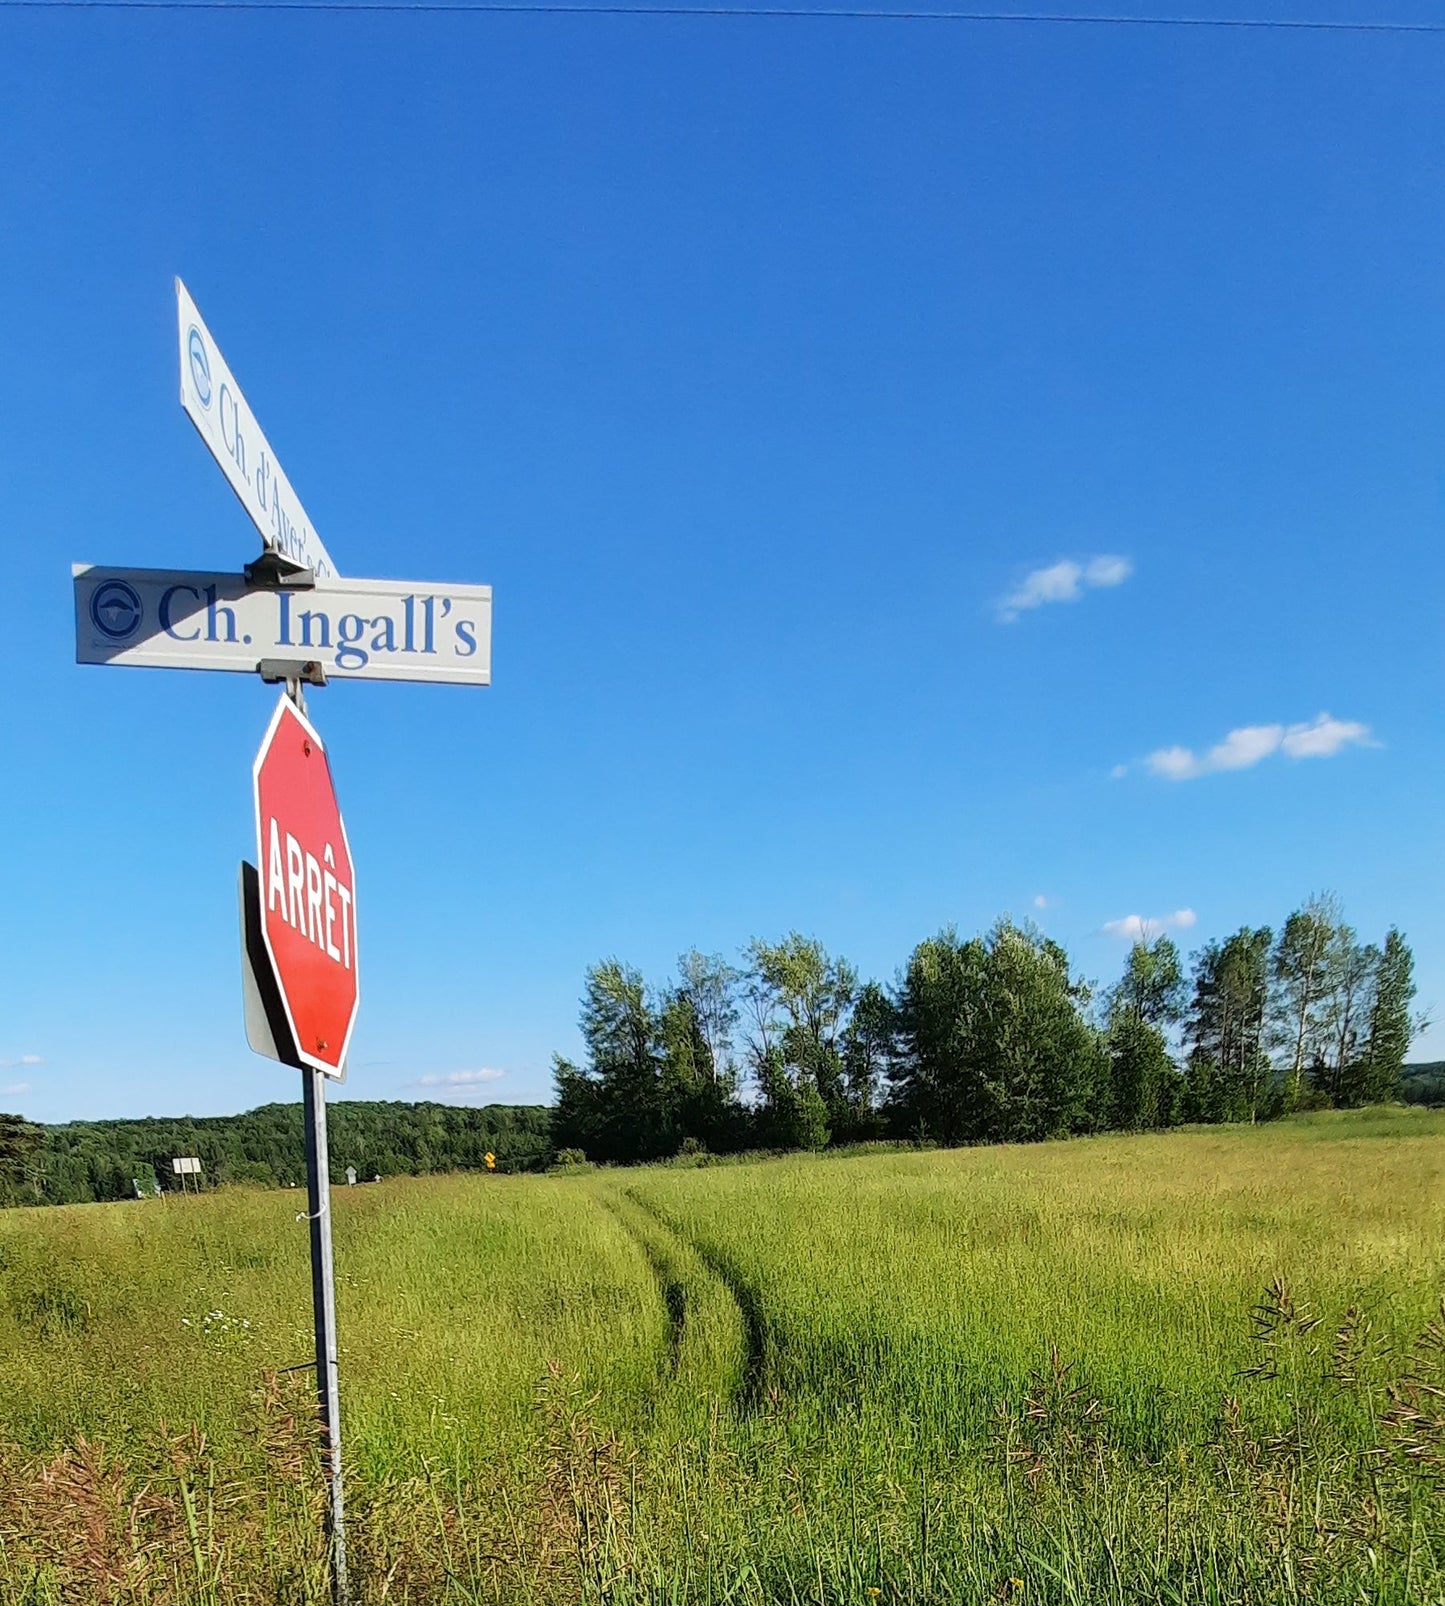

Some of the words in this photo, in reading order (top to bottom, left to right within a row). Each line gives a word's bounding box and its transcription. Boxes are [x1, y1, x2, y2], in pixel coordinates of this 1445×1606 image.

[219, 383, 251, 487] Ch.
[157, 584, 253, 645] Ch.
[274, 591, 478, 671] Ingall's
[268, 816, 352, 970] ARRÊT
